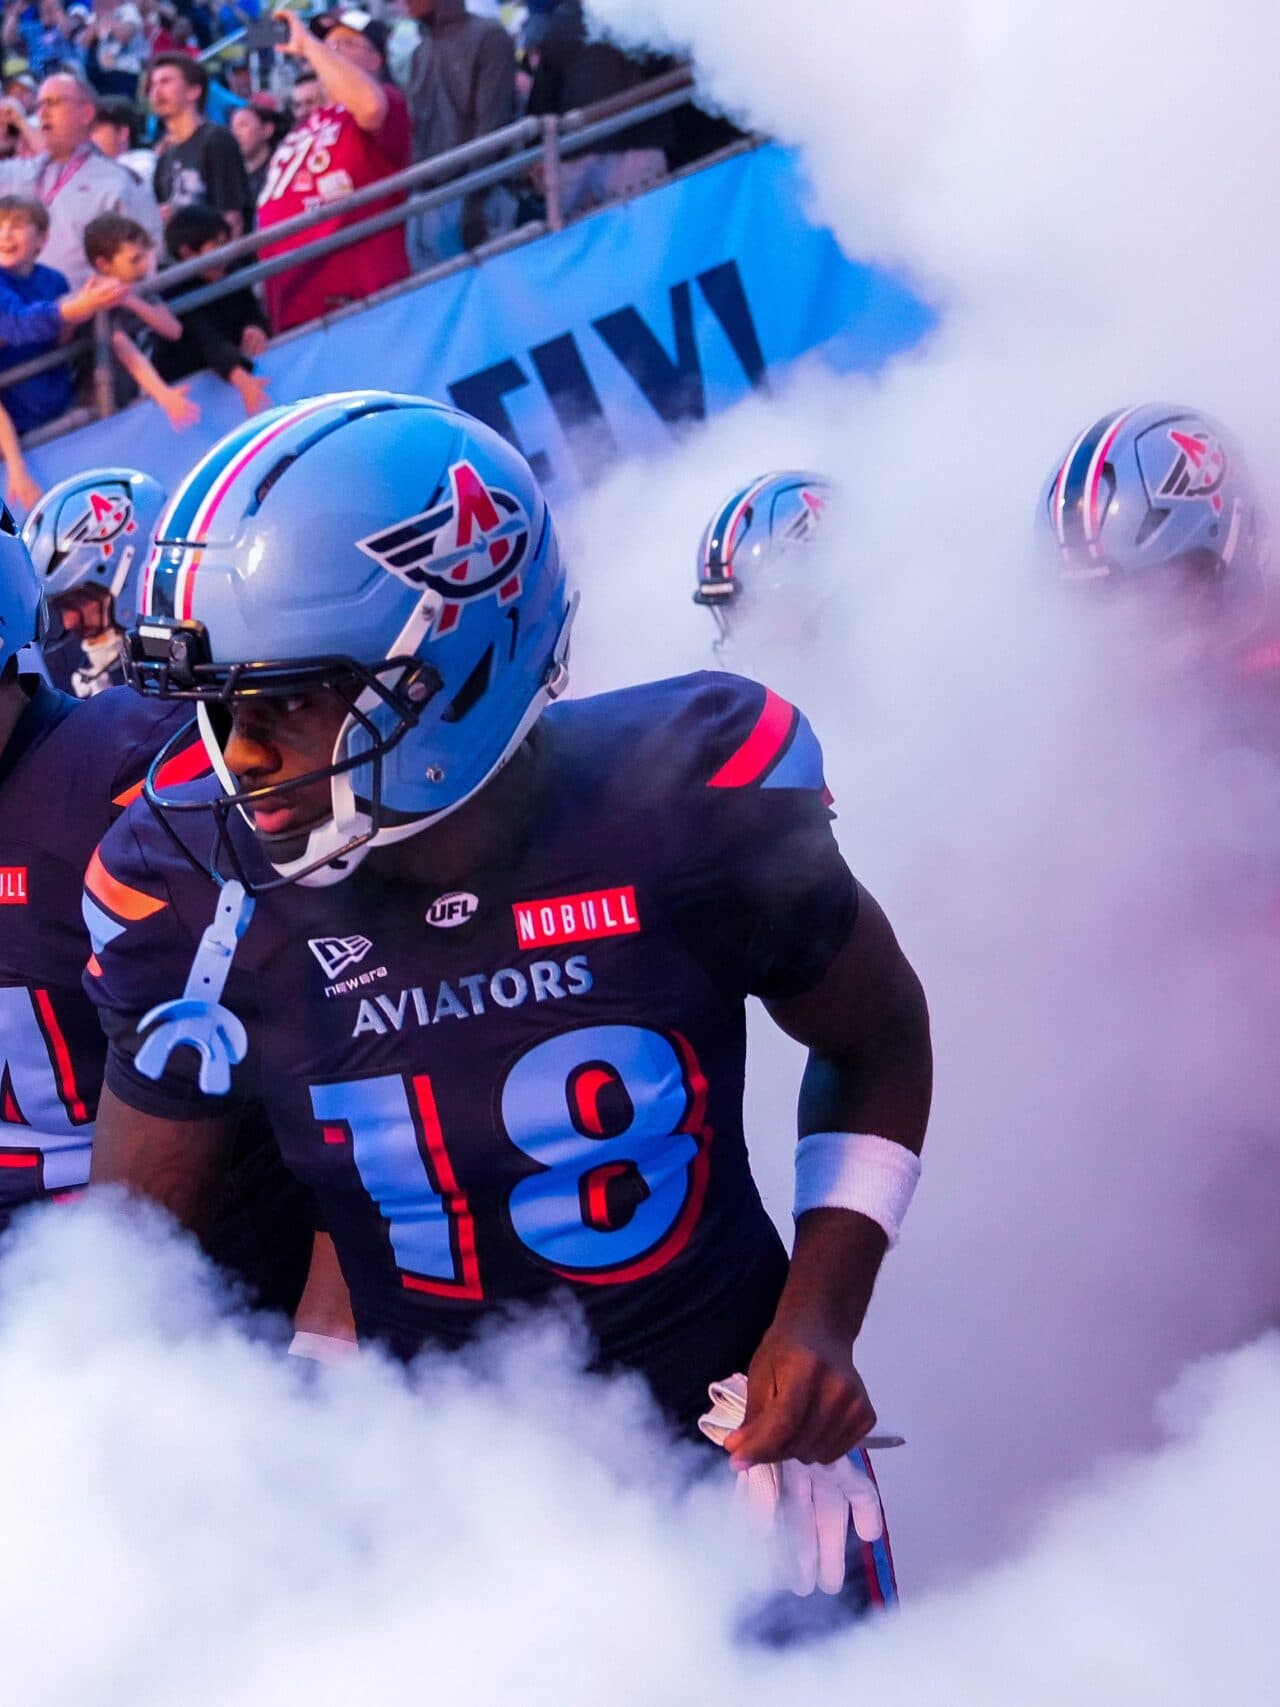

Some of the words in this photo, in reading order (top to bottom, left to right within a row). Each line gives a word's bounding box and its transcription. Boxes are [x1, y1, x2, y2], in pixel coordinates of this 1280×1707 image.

[429, 897, 477, 924] UFL
[519, 894, 637, 942] NOBULL
[351, 954, 594, 1038] AVIATORS
[308, 1024, 714, 1301] 18
